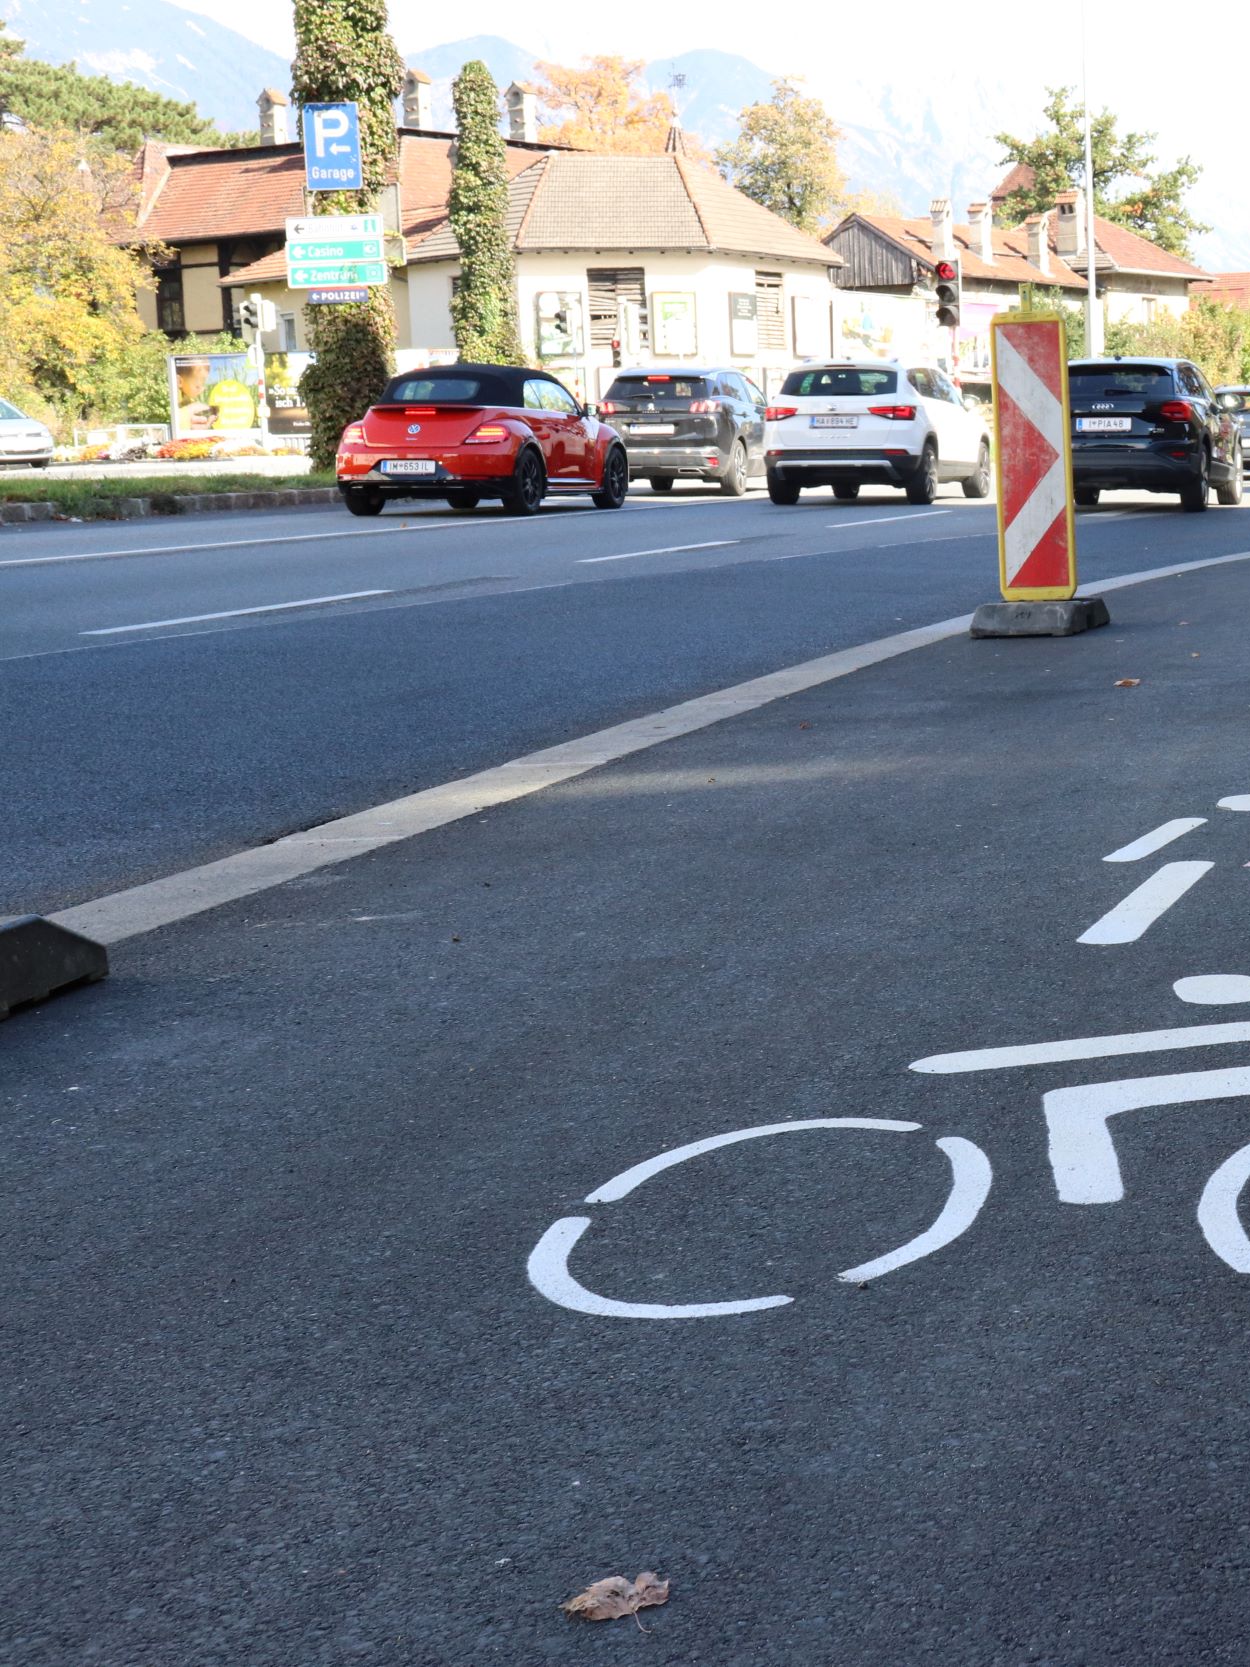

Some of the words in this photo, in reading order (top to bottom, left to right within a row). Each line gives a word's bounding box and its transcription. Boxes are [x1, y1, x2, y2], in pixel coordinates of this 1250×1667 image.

[314, 109, 350, 158] P
[311, 166, 355, 181] Garage
[307, 245, 344, 258] Casino
[310, 269, 358, 282] Zentrum
[321, 291, 360, 301] POLIZEI
